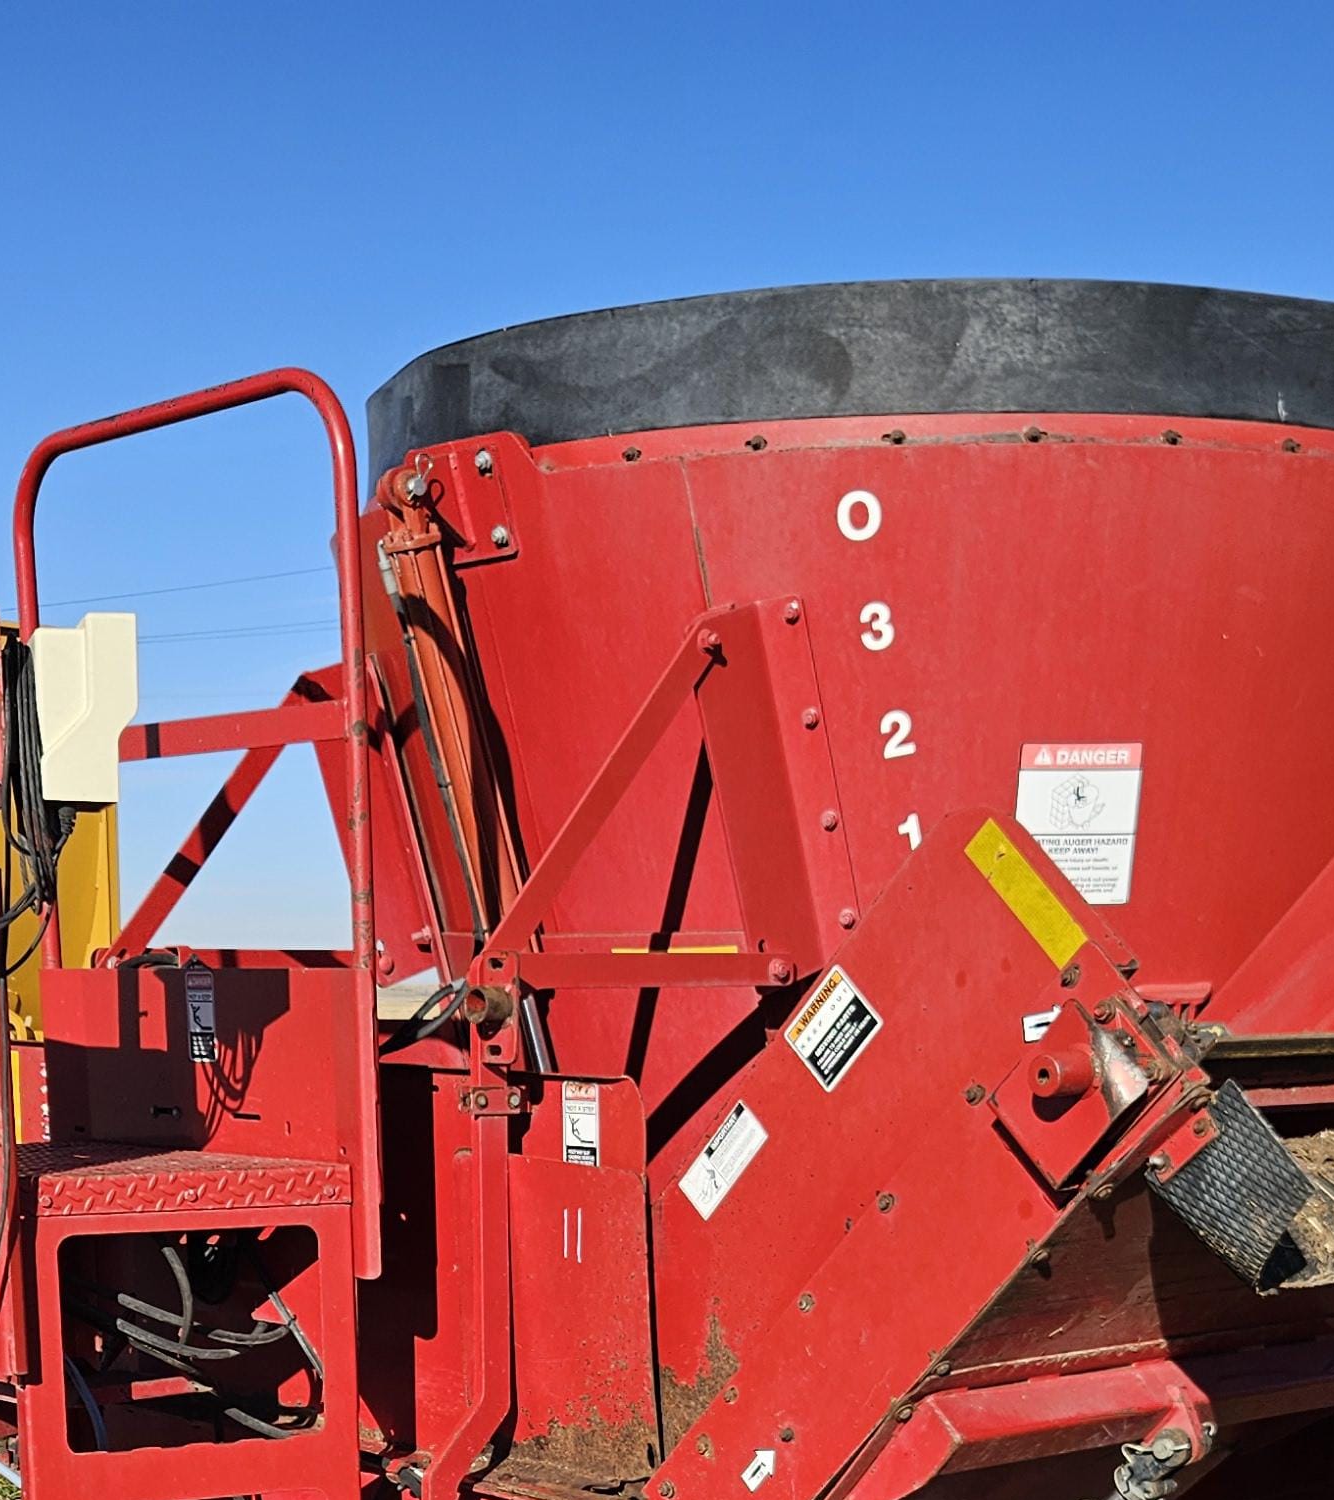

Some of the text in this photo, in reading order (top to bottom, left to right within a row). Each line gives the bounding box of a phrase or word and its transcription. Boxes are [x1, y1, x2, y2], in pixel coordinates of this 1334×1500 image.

[859, 602, 895, 651] 3
[879, 710, 916, 759] 2
[1056, 750, 1129, 765] DANGER
[898, 813, 922, 850] 1
[801, 978, 837, 1026] WARNING
[710, 1113, 737, 1151] IMPORTANT
